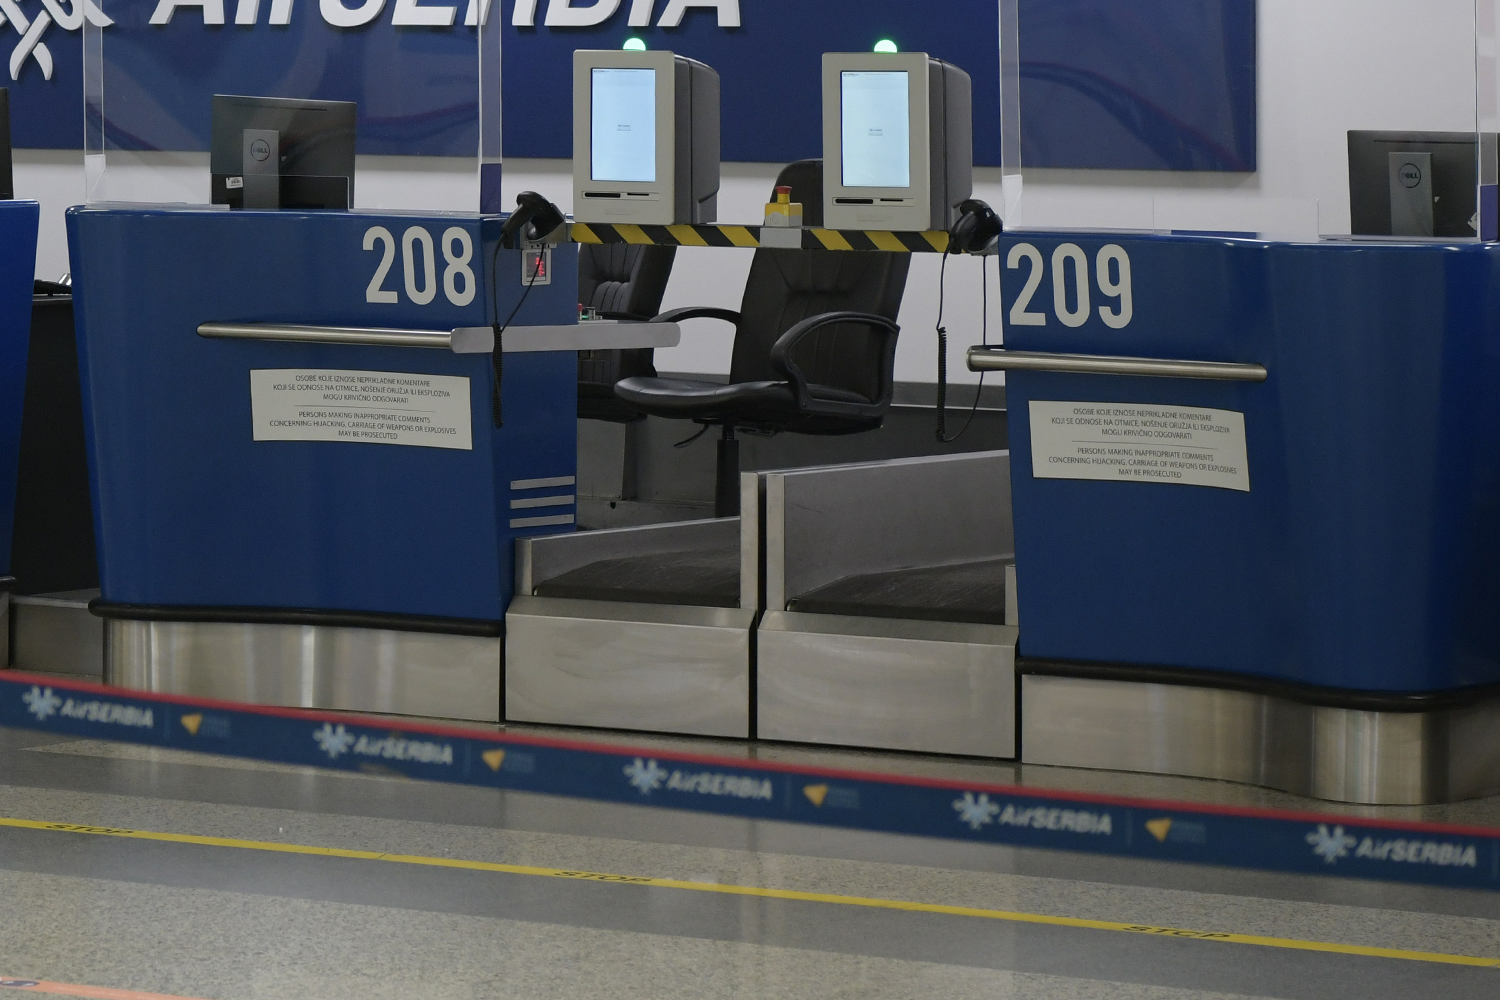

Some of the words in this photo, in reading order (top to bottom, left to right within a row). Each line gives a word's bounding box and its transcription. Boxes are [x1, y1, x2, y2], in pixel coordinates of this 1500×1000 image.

[362, 225, 476, 307] 208
[1007, 242, 1133, 329] 209
[1137, 411, 1178, 419] NEPRIKLADNE
[1179, 413, 1212, 421] KOMENTARE
[1154, 431, 1192, 439] ODGOVARATI
[1135, 450, 1180, 458] INAPPROPRIATE
[1182, 453, 1213, 461] COMMENTS
[1128, 459, 1158, 467] CARRIAGE
[1143, 470, 1182, 478] PROSECUTED
[554, 871, 651, 882] STOP
[1123, 926, 1230, 938] STOP
